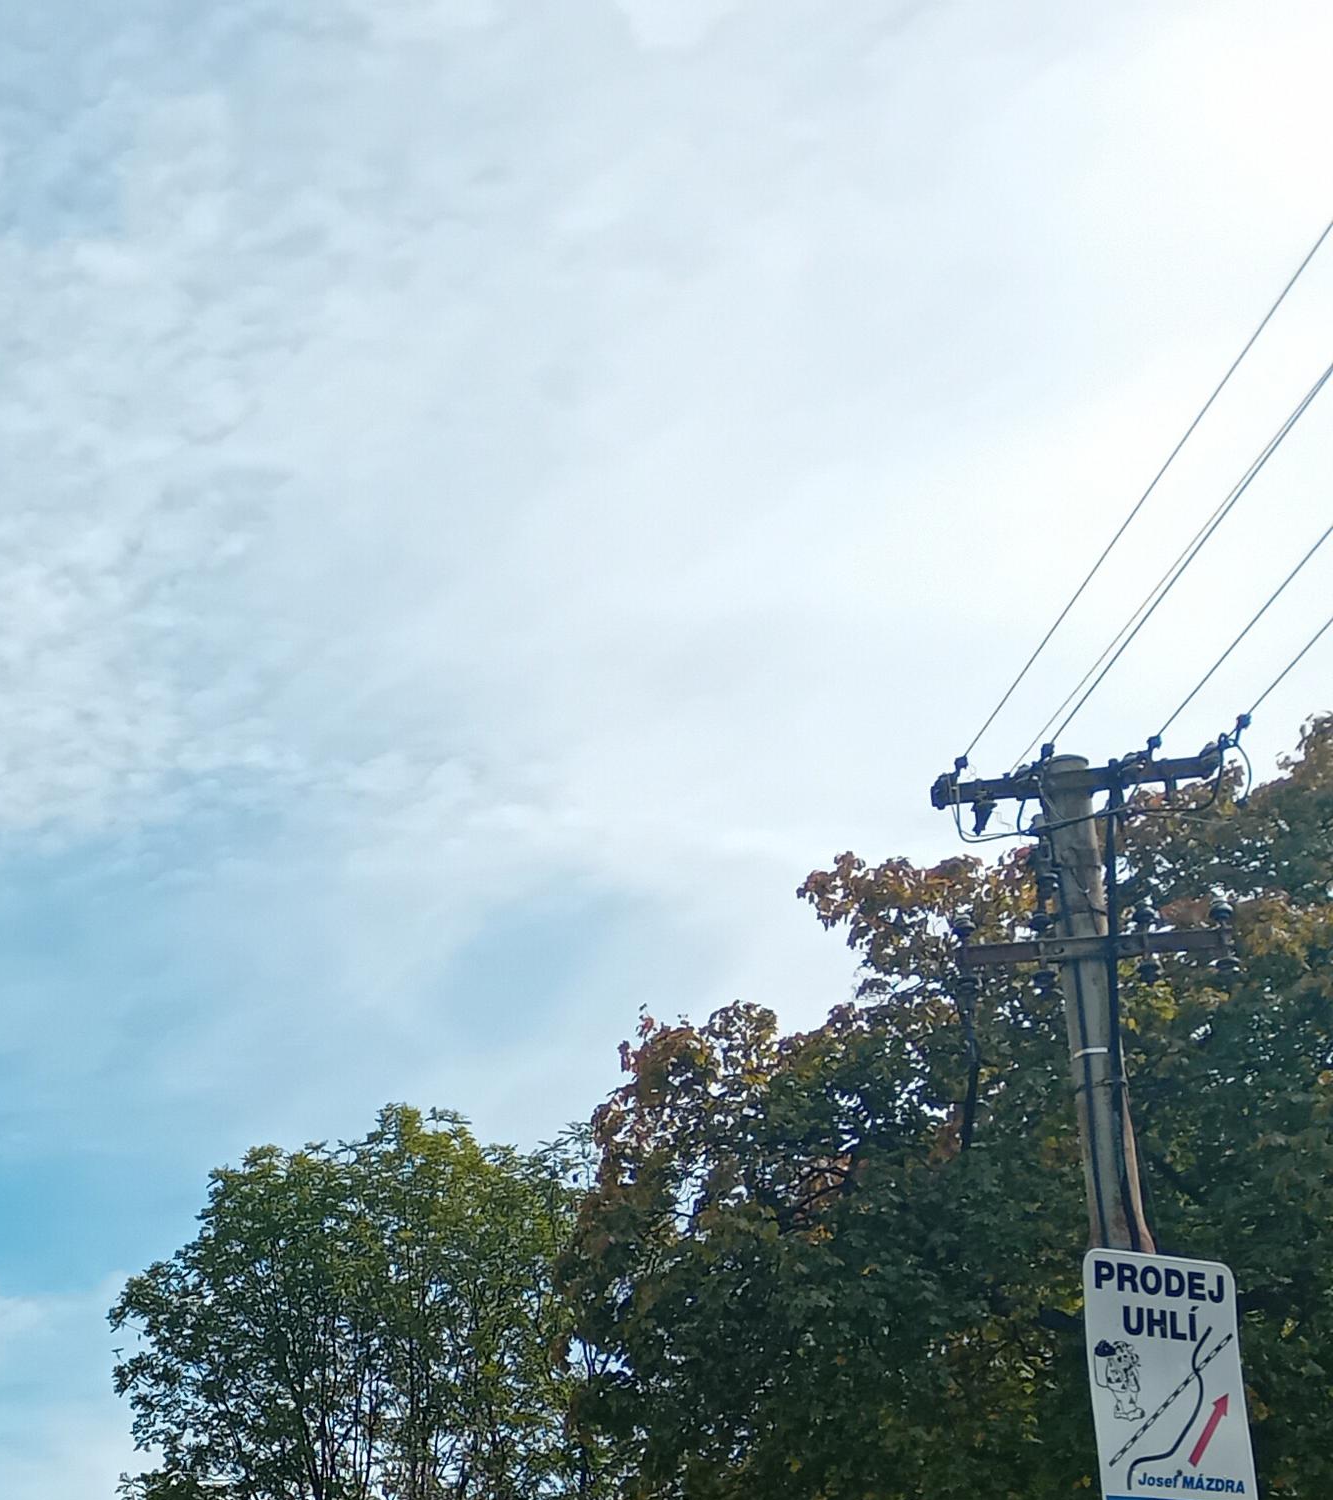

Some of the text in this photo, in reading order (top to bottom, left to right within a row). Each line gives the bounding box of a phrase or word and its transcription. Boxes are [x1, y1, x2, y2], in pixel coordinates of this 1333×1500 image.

[1093, 1260, 1225, 1304] PRODEJ
[1121, 1305, 1200, 1342] UHLÍ
[1137, 1471, 1245, 1494] Josef MÁZDRA
